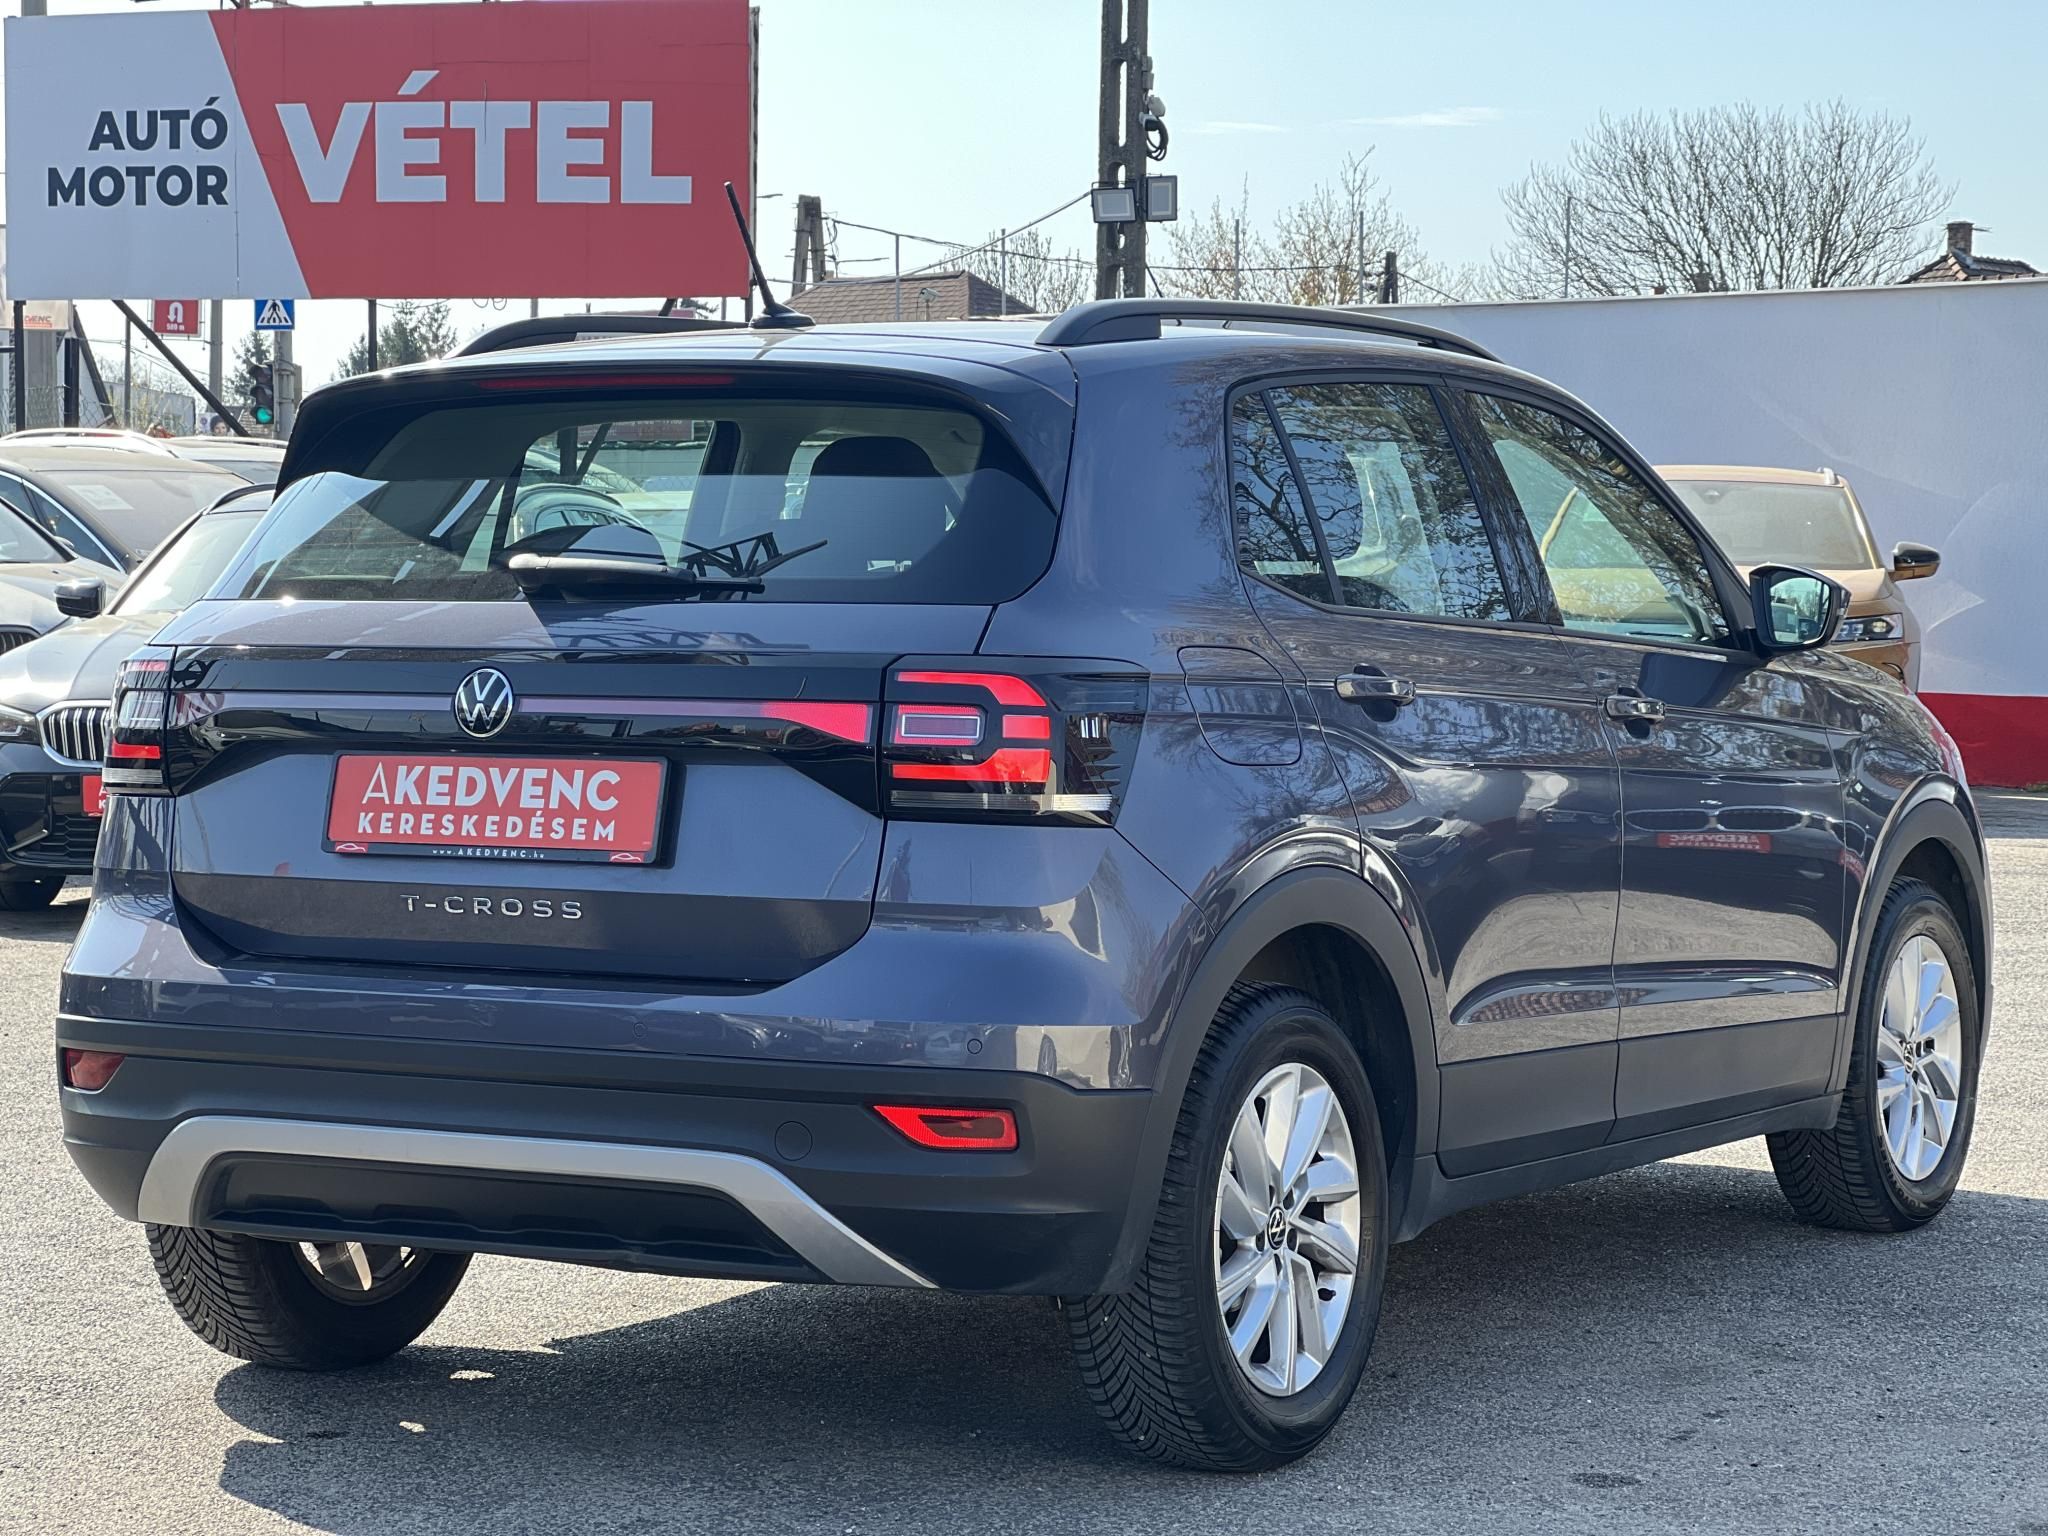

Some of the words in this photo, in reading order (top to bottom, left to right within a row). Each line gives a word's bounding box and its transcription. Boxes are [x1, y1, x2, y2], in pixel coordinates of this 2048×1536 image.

[88, 96, 228, 151] AUTÓ
[275, 70, 692, 204] VÉTEL
[48, 165, 229, 207] MOTOR
[361, 761, 621, 811] AKEDVENC
[358, 810, 615, 842] KERESKEDÉSEM
[432, 847, 545, 859] www.AKEDVENC.hu
[400, 894, 582, 919] T-CROSS
